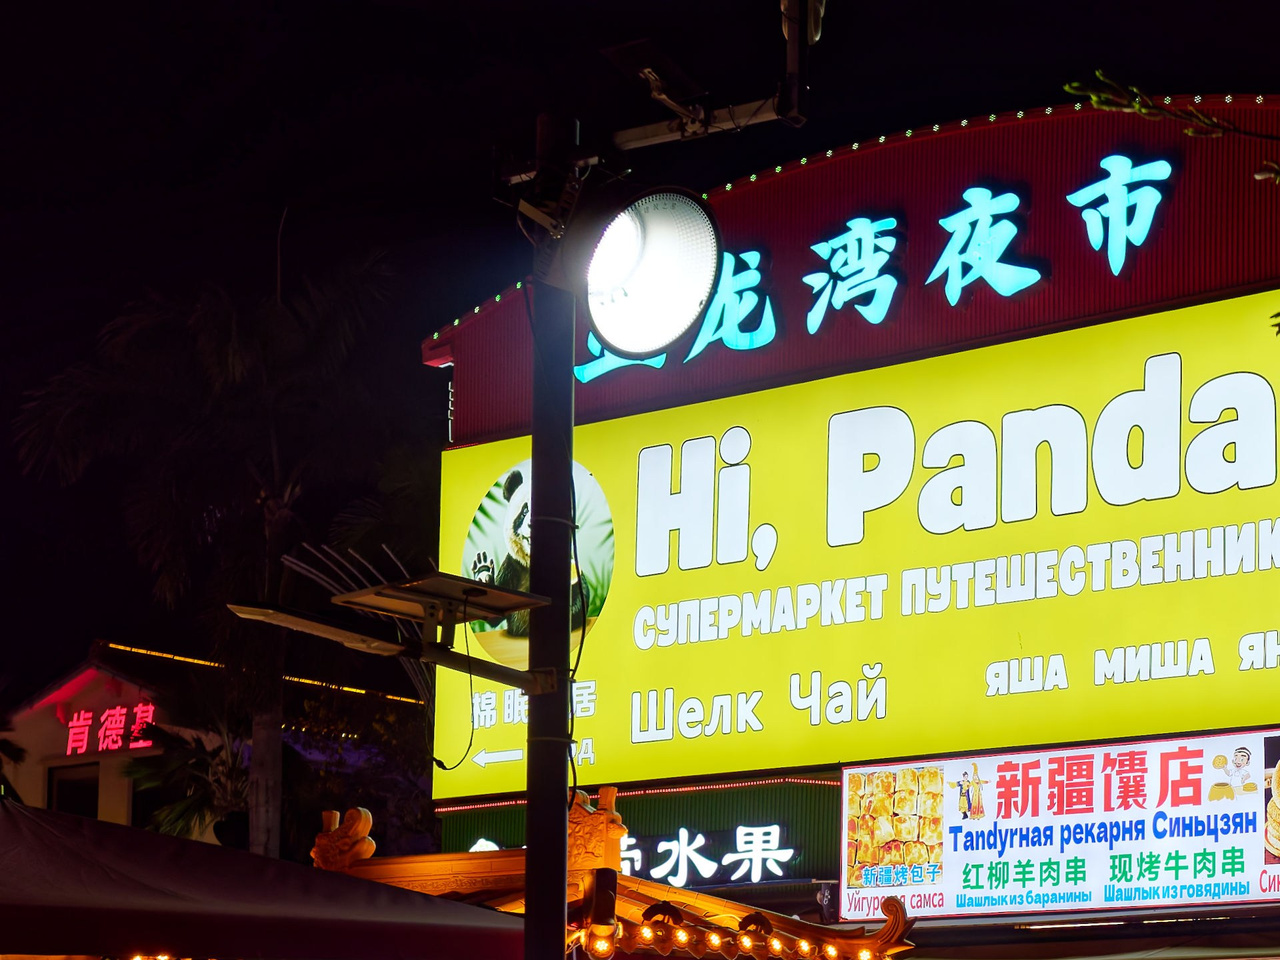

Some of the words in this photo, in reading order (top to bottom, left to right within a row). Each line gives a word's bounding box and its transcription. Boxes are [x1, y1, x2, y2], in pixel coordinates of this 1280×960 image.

[573, 153, 1174, 383] 龙湾夜市
[634, 424, 779, 578] Hi,
[633, 572, 889, 651] СУПЕРМАРКЕТ
[986, 653, 1070, 698] ЯША
[1093, 635, 1215, 688] МИША
[472, 680, 597, 730] 棉眠居
[630, 686, 765, 745] Шелк
[789, 662, 888, 727] Чай
[996, 746, 1205, 821] 新疆馕店
[1153, 811, 1257, 843] Синьцзян
[862, 863, 941, 886] 新疆烤包子
[962, 856, 1086, 890] 红柳羊肉串
[1110, 846, 1245, 882] 现烤牛肉串
[1103, 883, 1161, 902] Шашлык
[1179, 881, 1251, 900] говядины
[910, 892, 944, 910] самса
